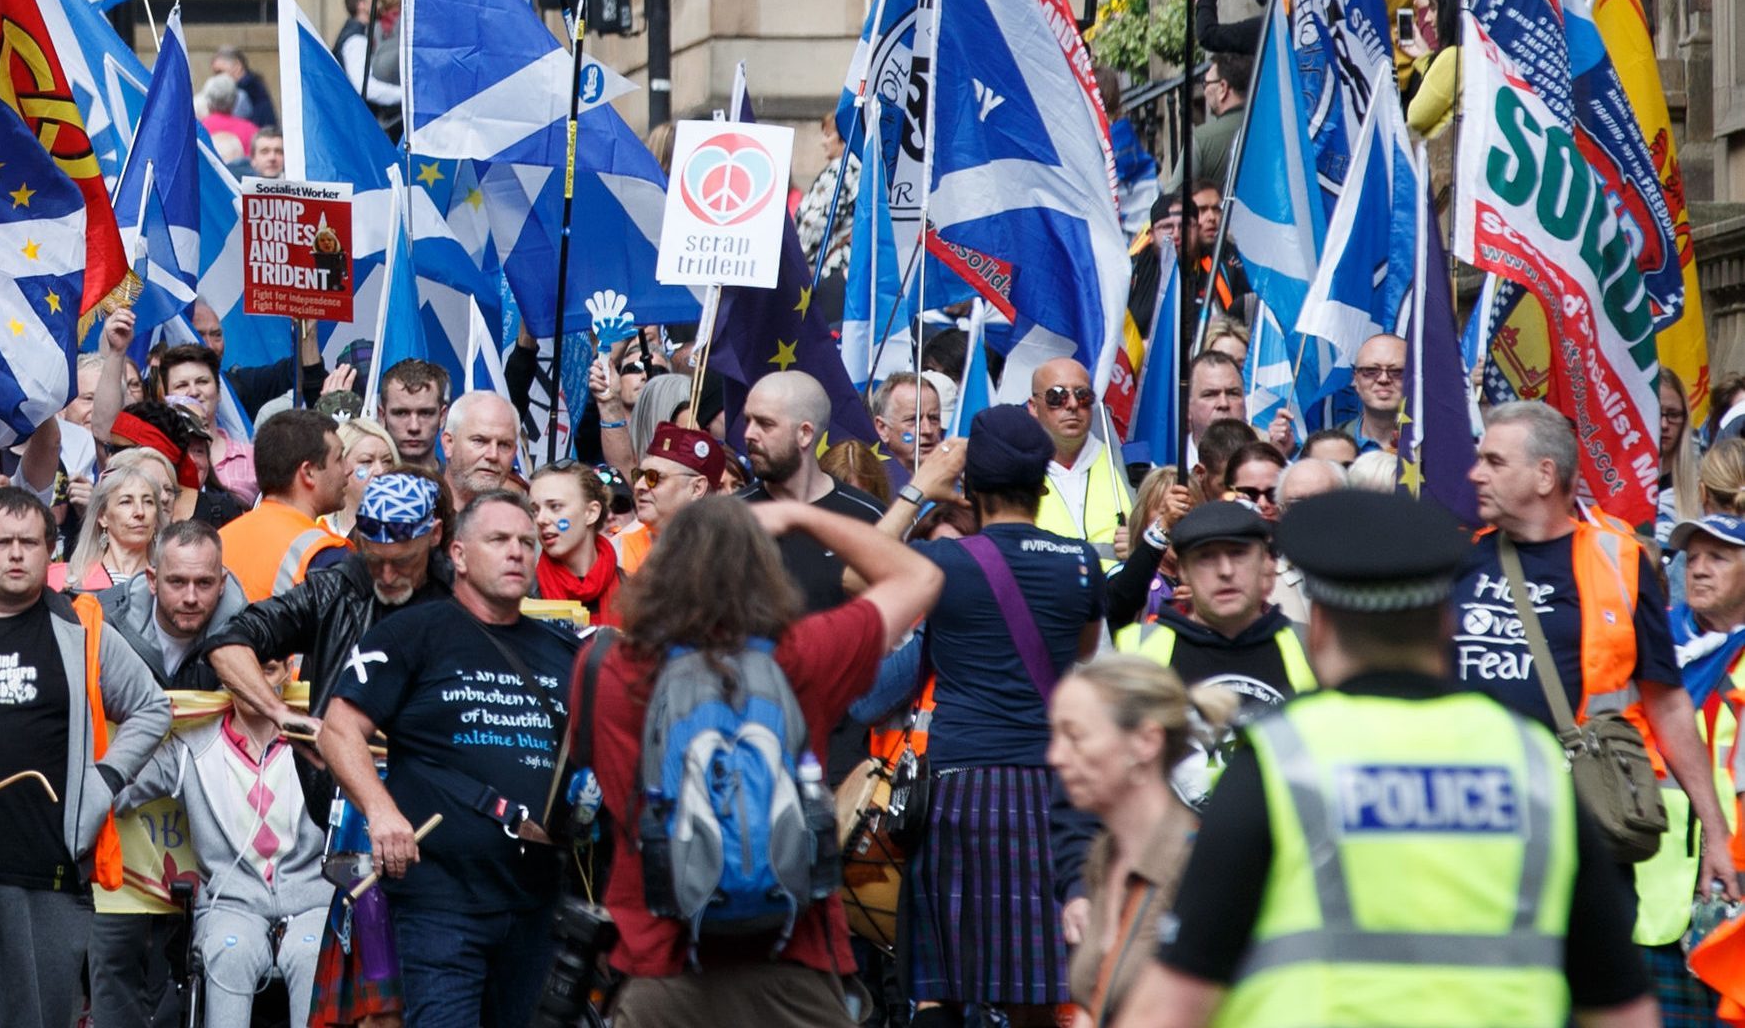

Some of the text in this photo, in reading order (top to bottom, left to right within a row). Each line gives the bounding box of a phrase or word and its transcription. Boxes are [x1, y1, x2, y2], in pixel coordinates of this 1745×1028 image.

[582, 65, 599, 102] Yes
[1589, 98, 1625, 149] FIGHTING,
[255, 182, 340, 199] Socialist Worker
[247, 198, 305, 223] DUMP
[247, 219, 317, 247] TORIES
[685, 233, 751, 256] scrap
[249, 240, 289, 264] AND
[249, 261, 331, 291] TRIDENT
[677, 255, 757, 278] trident
[253, 289, 342, 308] Fight for independence
[253, 299, 326, 316] Fight for socialism
[1457, 644, 1535, 681] Fear
[475, 669, 495, 683] an
[441, 684, 525, 706] unbroken
[460, 707, 555, 730] of beautiful
[452, 728, 516, 748] saltire
[1339, 767, 1518, 828] POLICE
